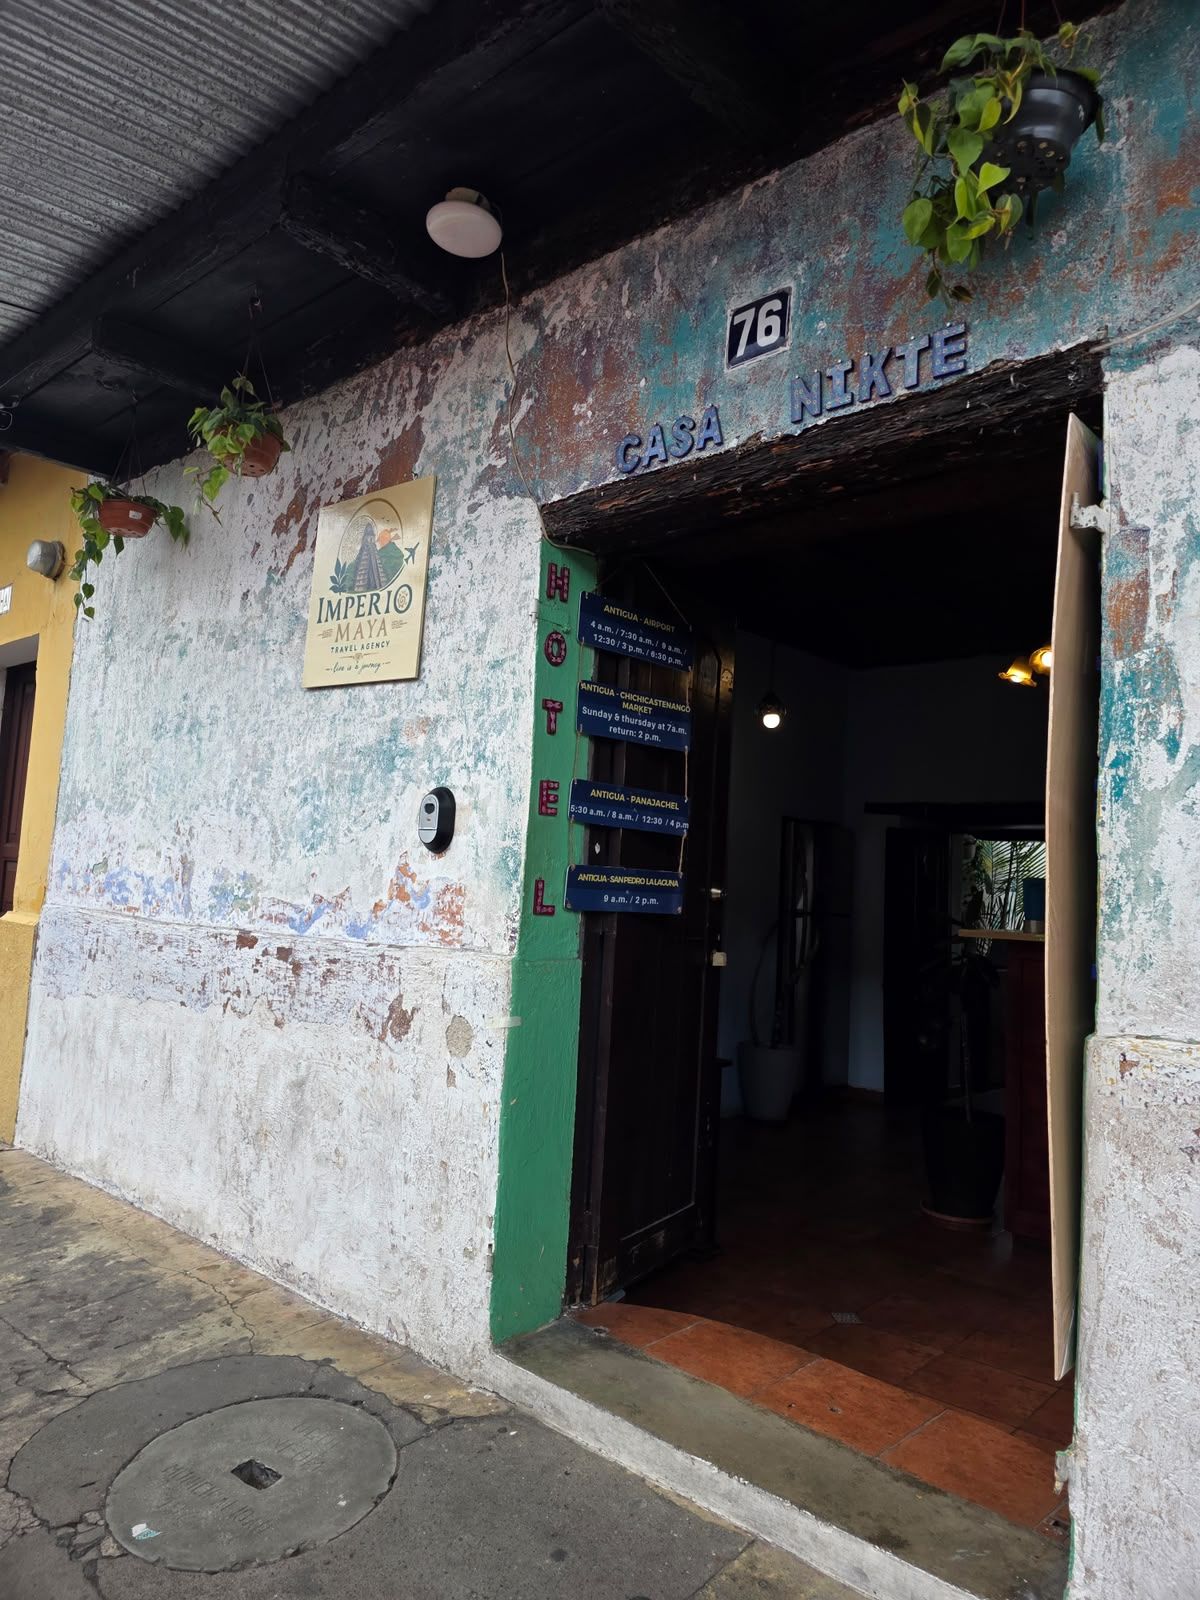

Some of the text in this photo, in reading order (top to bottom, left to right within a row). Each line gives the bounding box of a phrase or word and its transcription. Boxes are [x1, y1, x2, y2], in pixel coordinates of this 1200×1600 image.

[732, 298, 782, 358] 76
[615, 322, 968, 474] CASA NIKTE
[316, 584, 412, 624] IMPERIO
[334, 617, 388, 643] MAYA
[603, 604, 639, 622] ANTIGUA
[643, 617, 676, 633] AIRPORT
[330, 640, 391, 654] TRAVEL AGENCY
[590, 620, 596, 628] 4
[597, 623, 614, 634] a.m.
[620, 629, 638, 641] 7:30
[638, 636, 654, 647] a.m.
[667, 644, 682, 654] a.m.
[593, 633, 616, 646] 12:30
[621, 642, 627, 650] 3
[628, 645, 645, 656] p.m.
[668, 655, 684, 666] p.m.
[581, 682, 615, 696] ANTIGUA
[620, 691, 691, 713] CHICHICASTENANGO
[622, 701, 652, 715] MARKET
[582, 706, 613, 721] Sunday
[614, 713, 620, 721] &
[621, 714, 656, 730] thursday
[657, 723, 666, 731] at
[533, 562, 570, 916] HOTEL
[609, 725, 662, 743] return: 2 p.m.
[590, 789, 625, 802] ANTIGUA
[630, 795, 680, 810] PANAJACHEL
[570, 804, 588, 815] 5:30
[589, 808, 606, 817] a.m.
[611, 810, 617, 819] 8
[618, 812, 634, 821] a.m.
[642, 815, 663, 825] 12:30
[669, 819, 675, 827] 4
[578, 873, 607, 883] ANTIGUA
[603, 894, 609, 903] 9
[611, 895, 628, 903] a.m.
[635, 896, 640, 904] 2
[641, 897, 659, 906] p.m.
